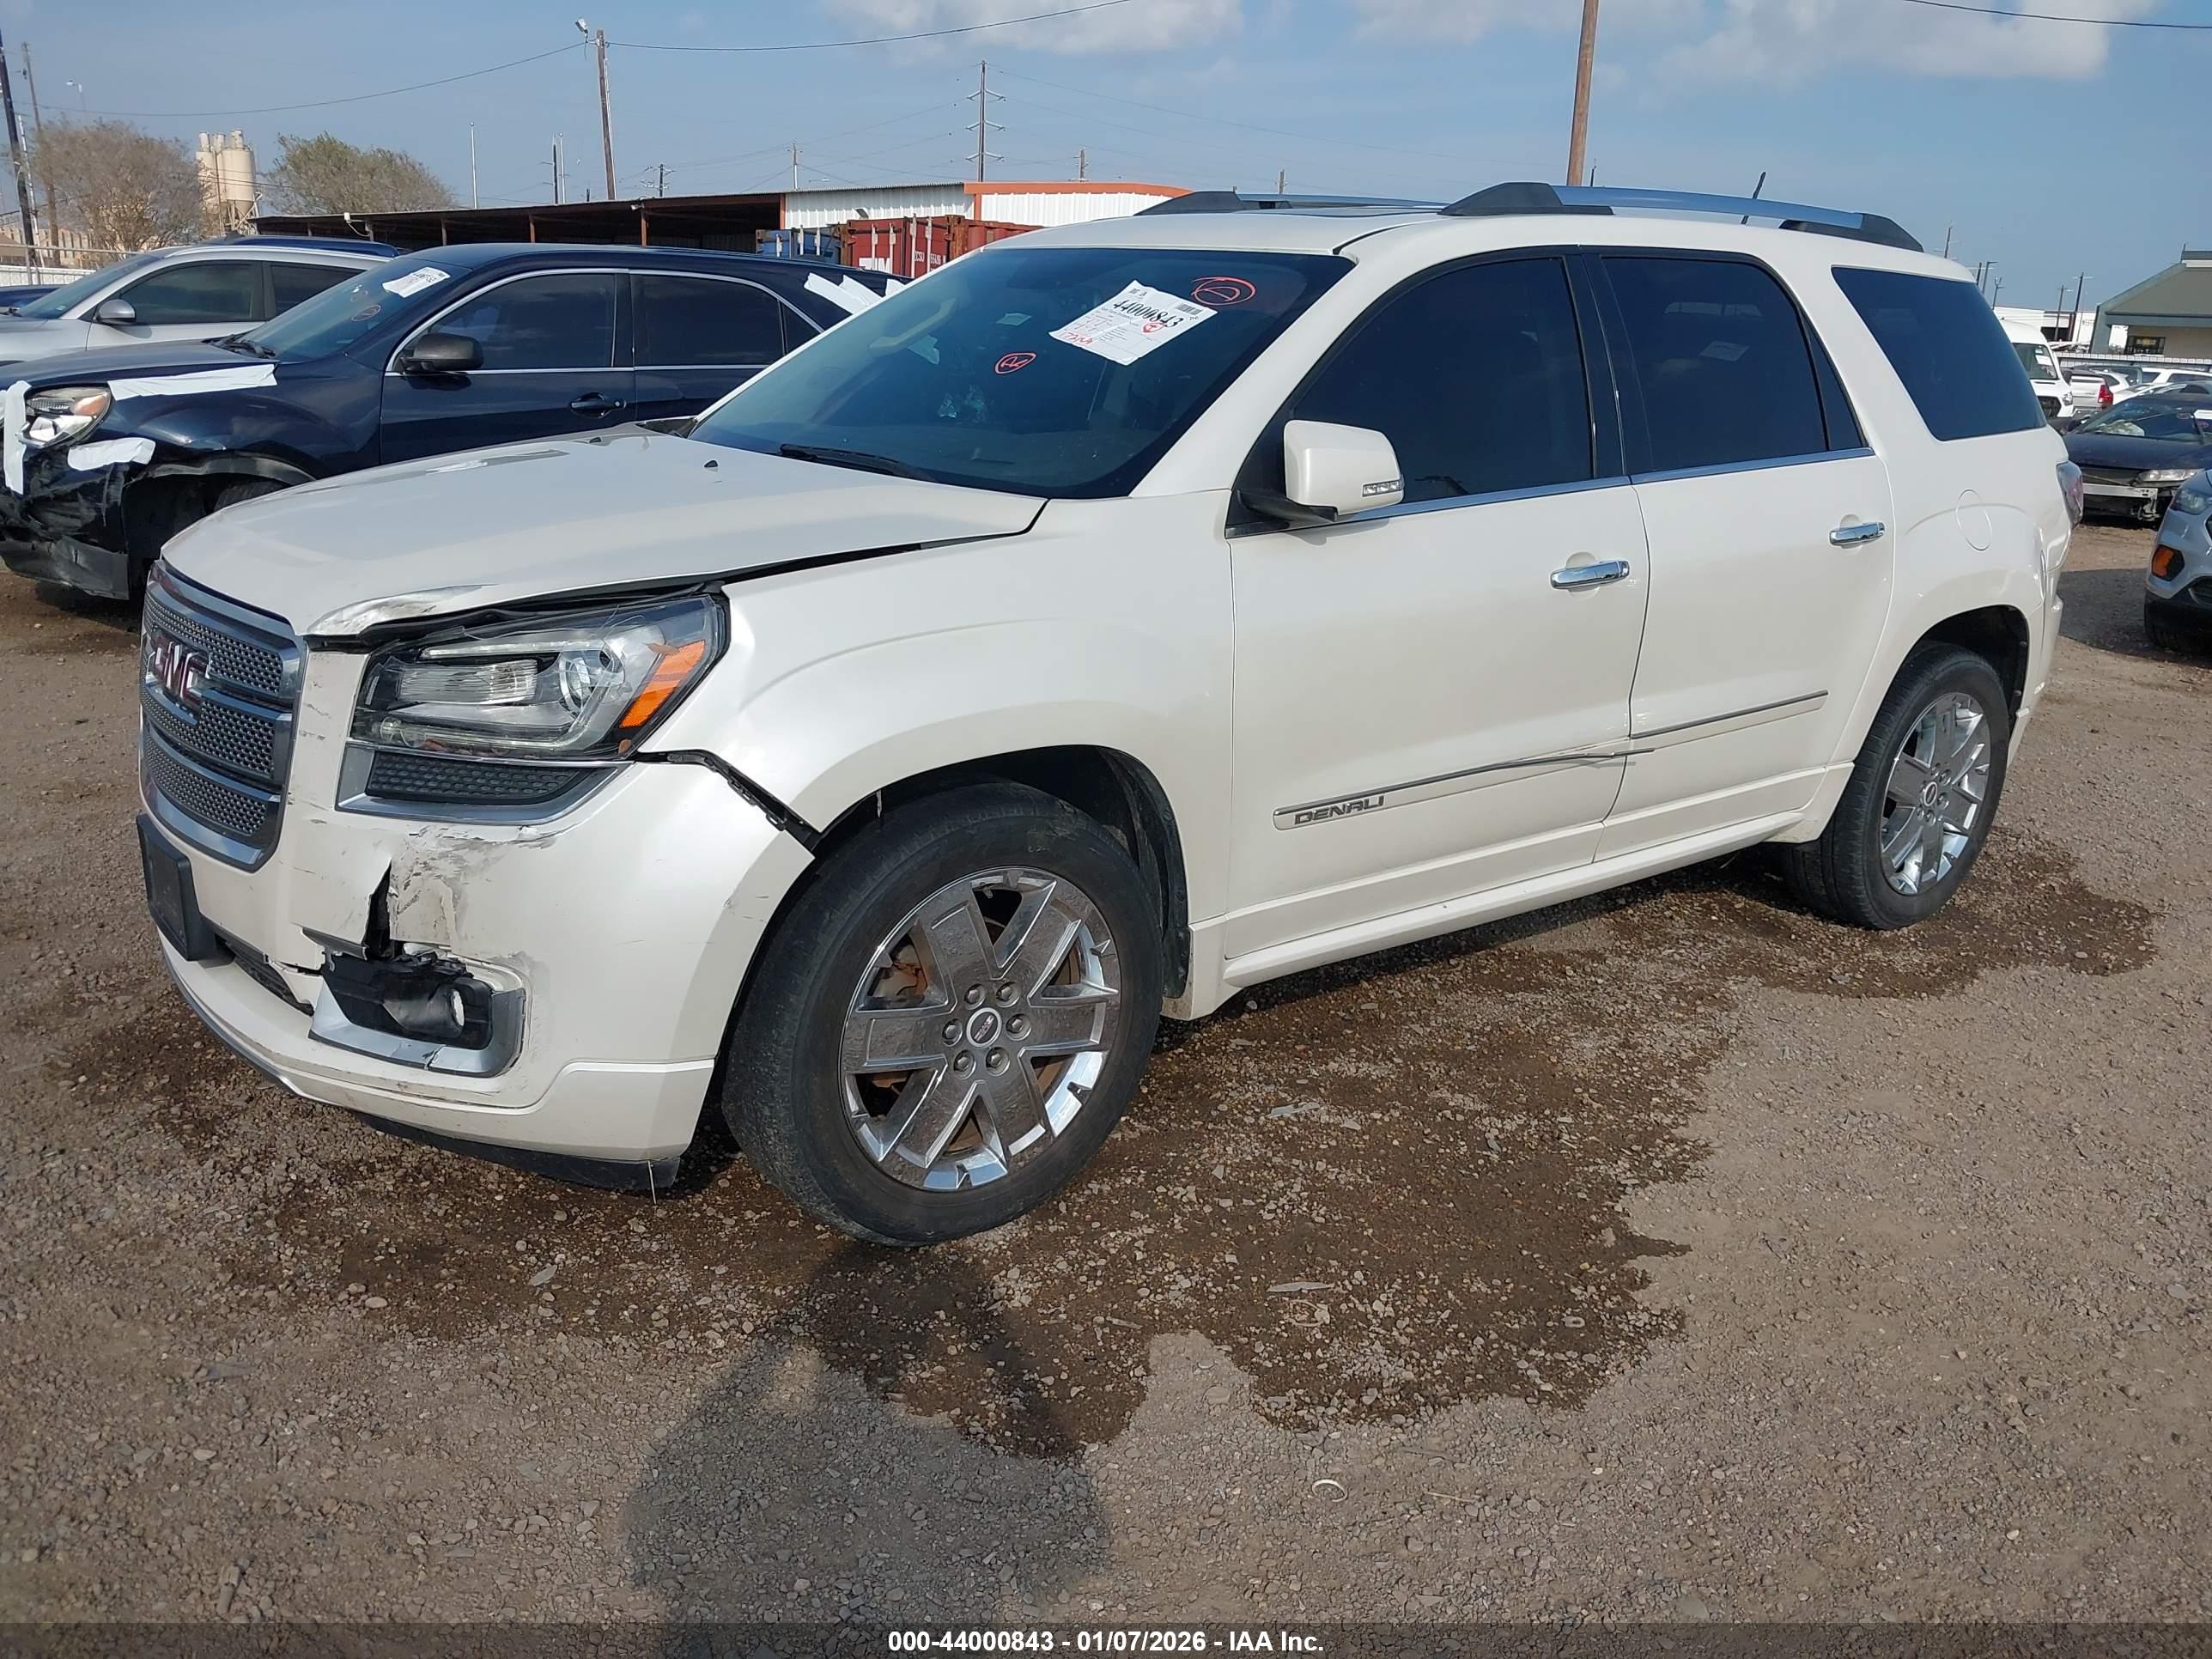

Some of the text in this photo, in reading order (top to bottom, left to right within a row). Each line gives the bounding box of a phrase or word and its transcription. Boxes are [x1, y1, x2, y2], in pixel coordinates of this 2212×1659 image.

[1114, 299, 1184, 328] 44000843
[146, 635, 212, 710] GMC
[1294, 795, 1384, 825] DENALI
